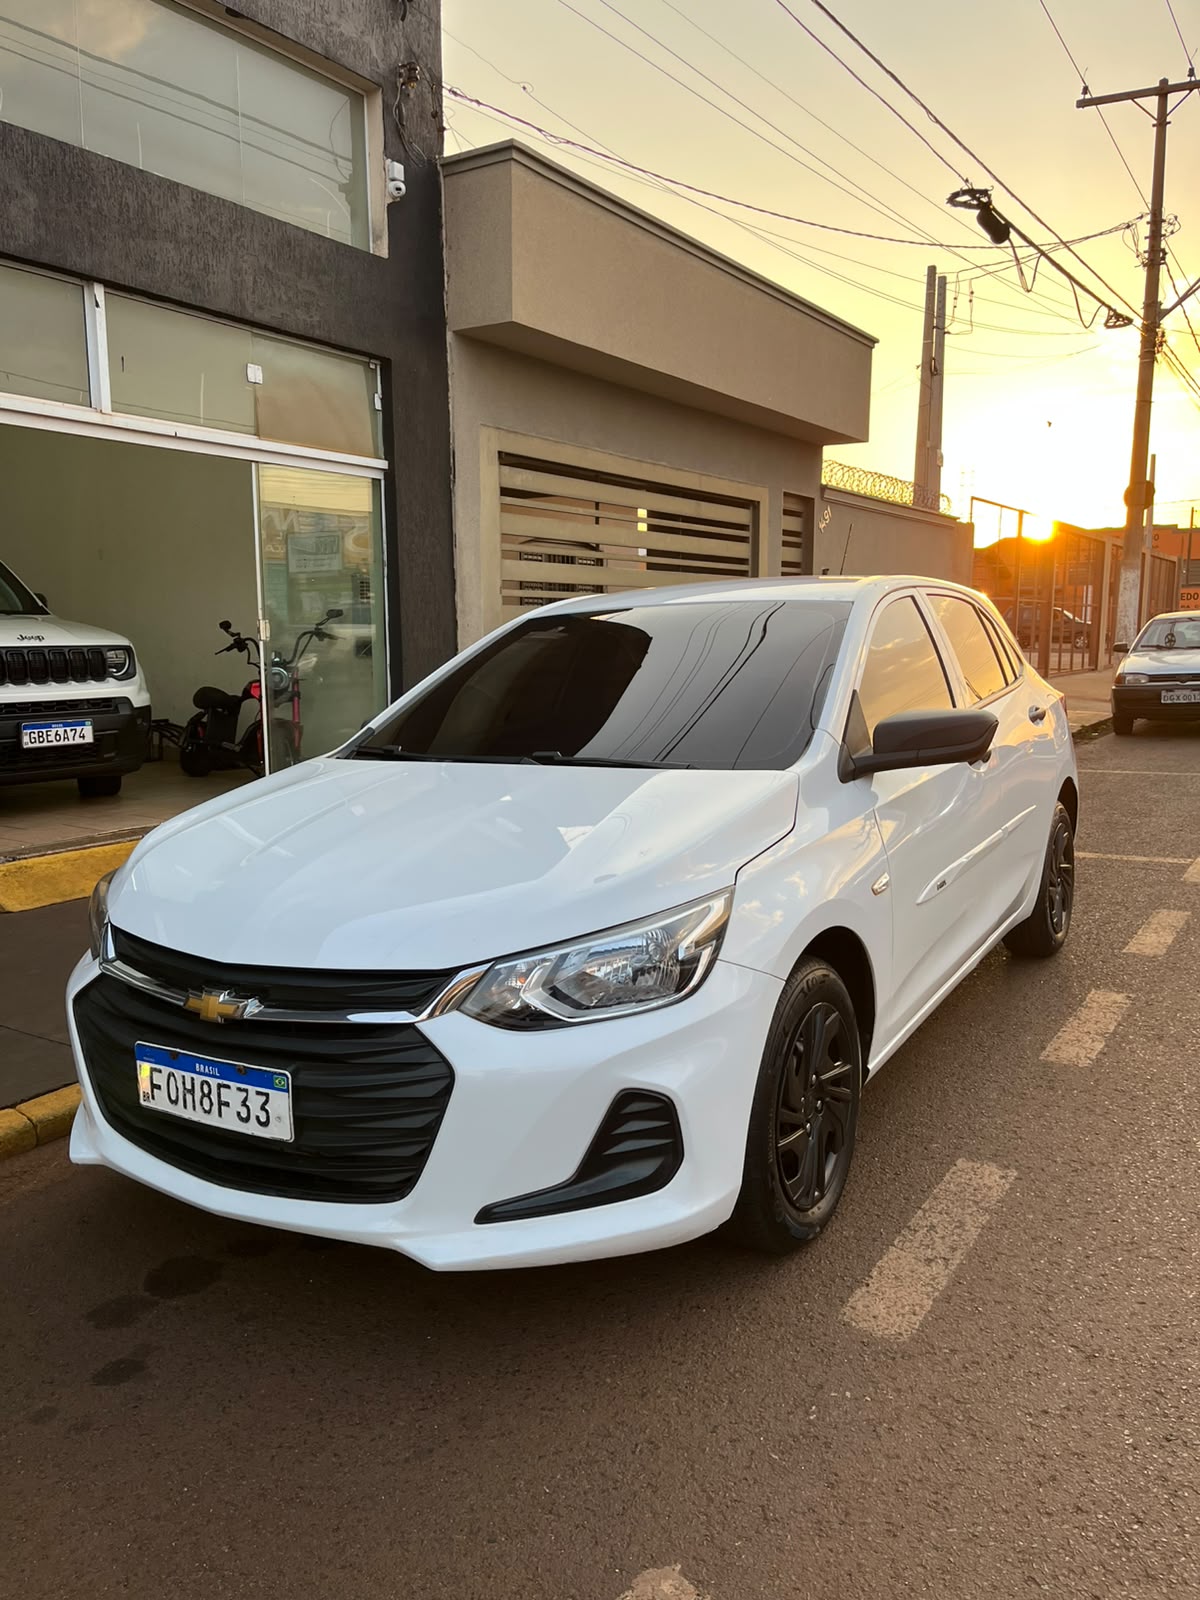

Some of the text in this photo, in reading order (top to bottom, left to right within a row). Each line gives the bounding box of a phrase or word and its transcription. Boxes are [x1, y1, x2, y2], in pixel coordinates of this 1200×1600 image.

[28, 727, 86, 745] GBE6A74
[195, 1062, 220, 1076] BRASIL
[150, 1065, 271, 1128] FOH8F33
